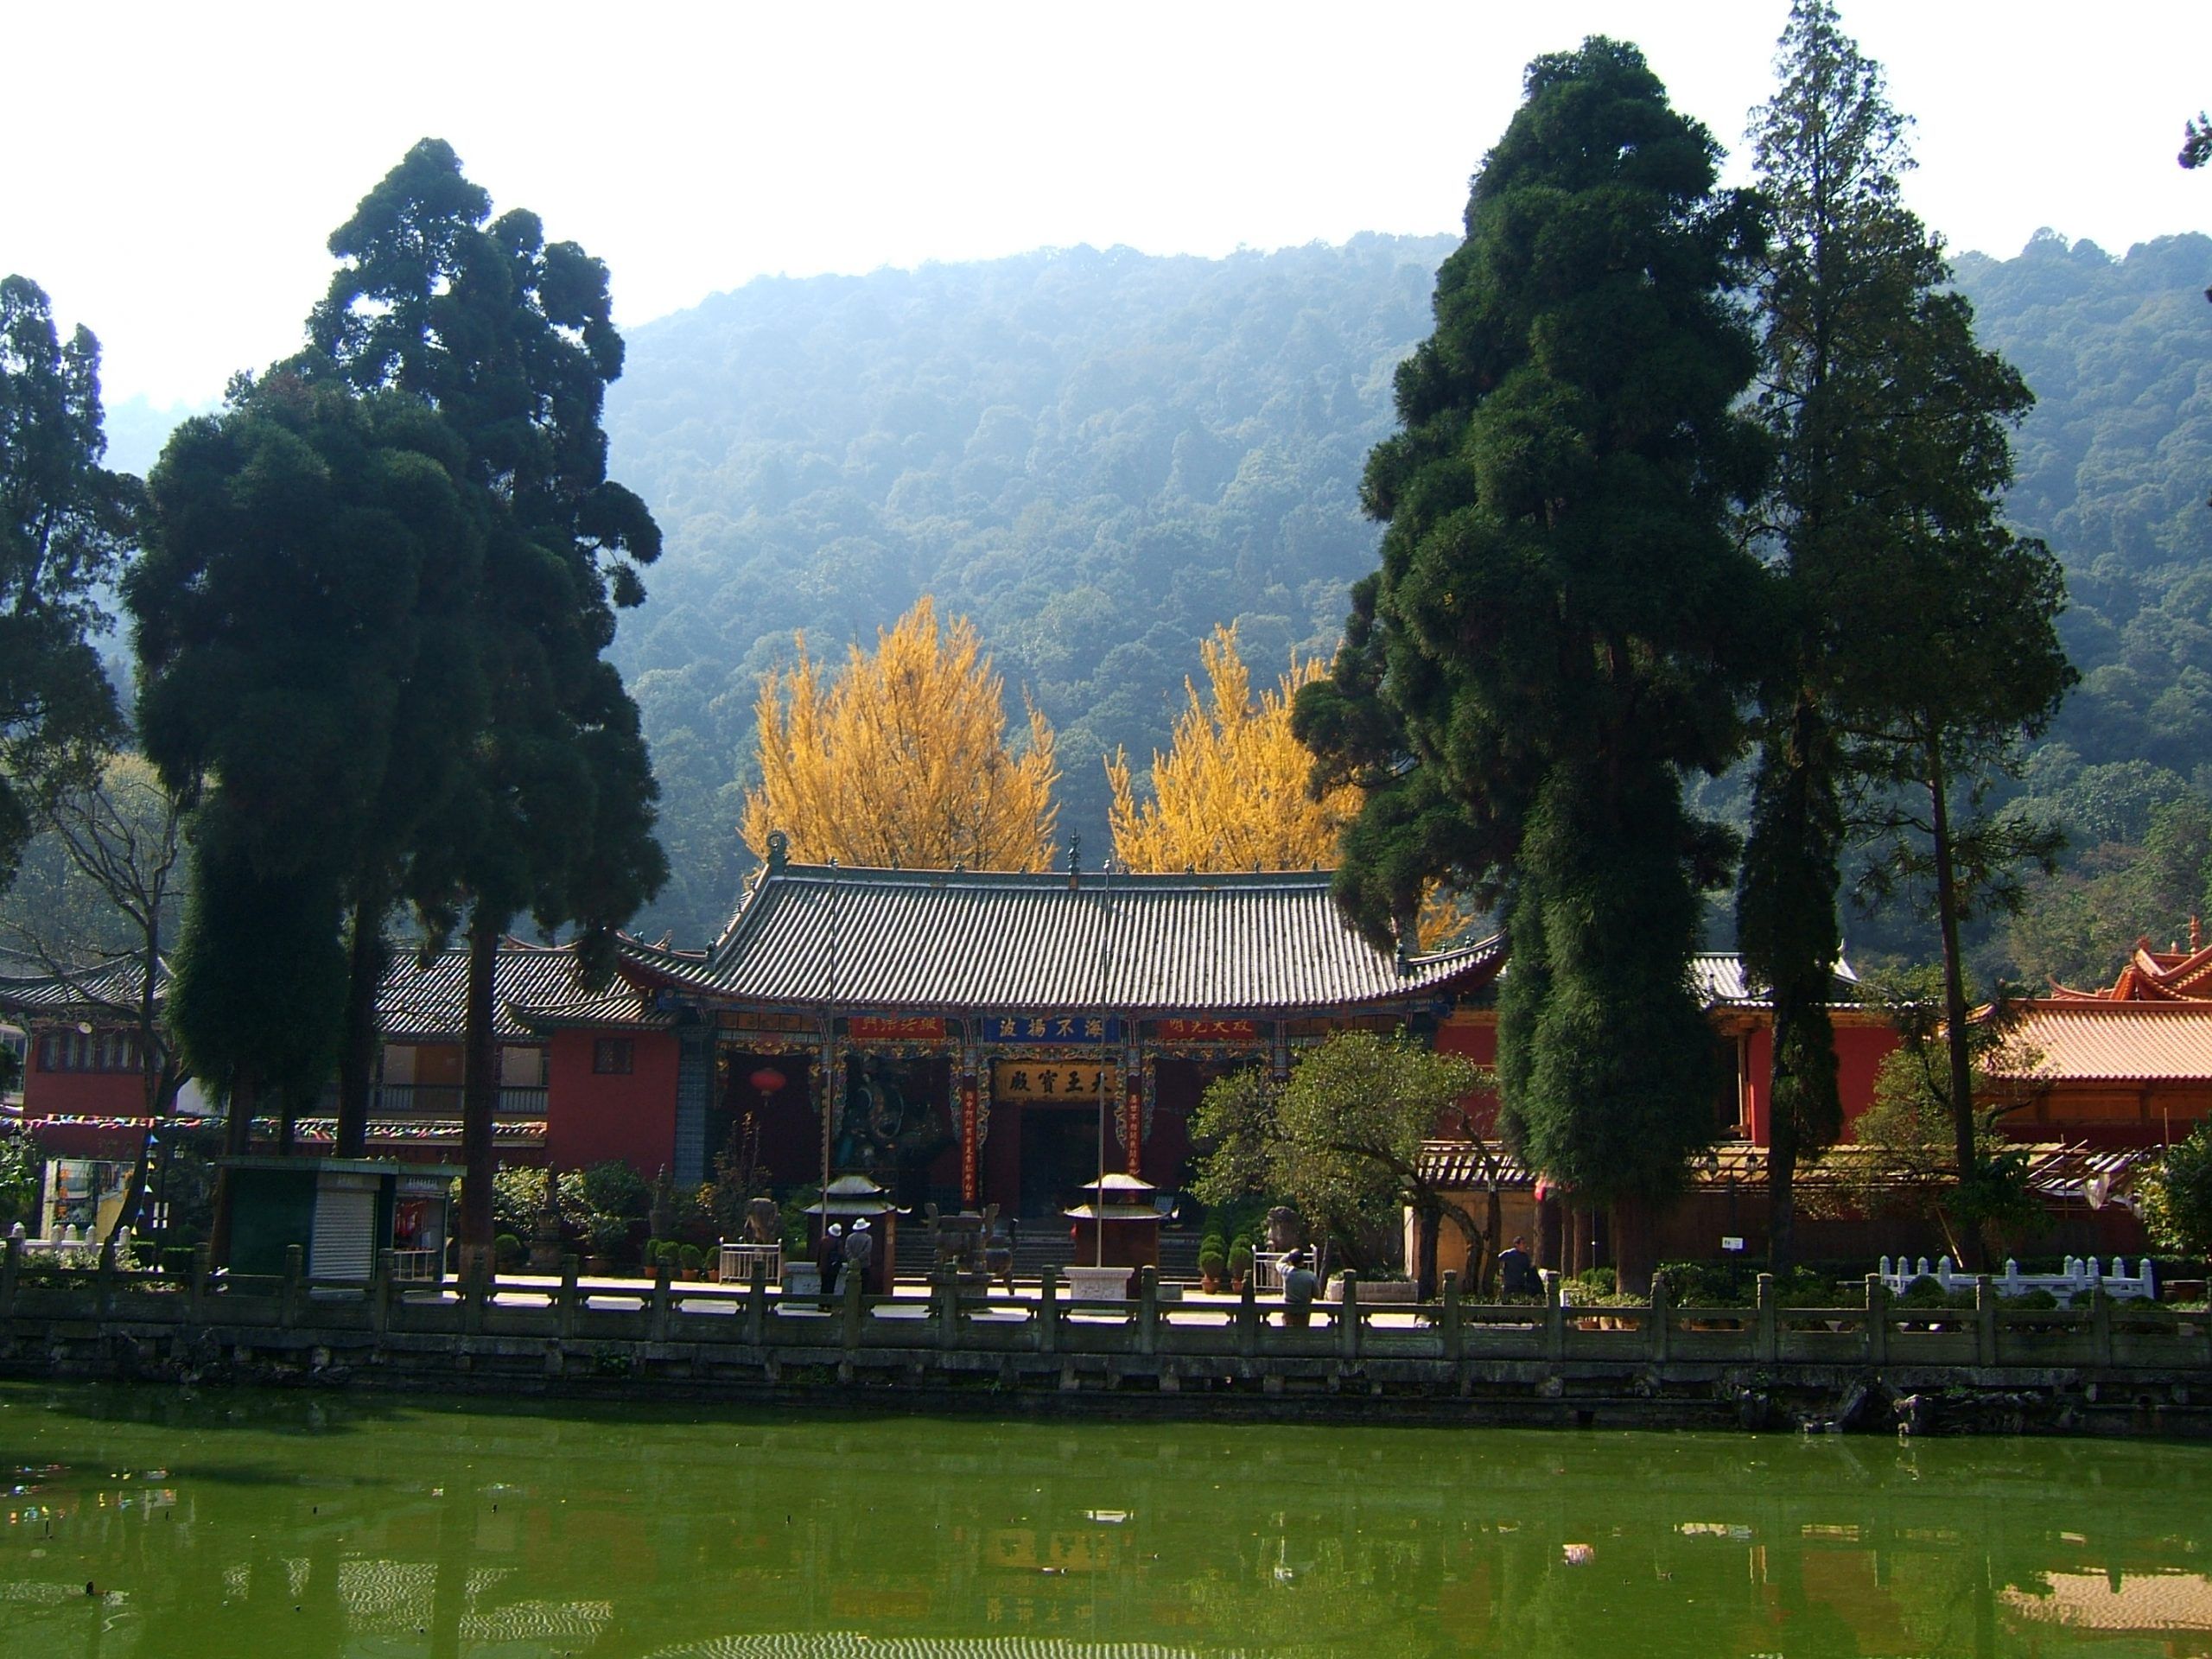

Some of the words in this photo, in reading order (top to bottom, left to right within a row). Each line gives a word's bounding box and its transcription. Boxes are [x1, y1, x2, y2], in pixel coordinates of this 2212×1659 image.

[1000, 1018, 1103, 1037] 海不揚波
[1169, 1018, 1252, 1033] 放大光明
